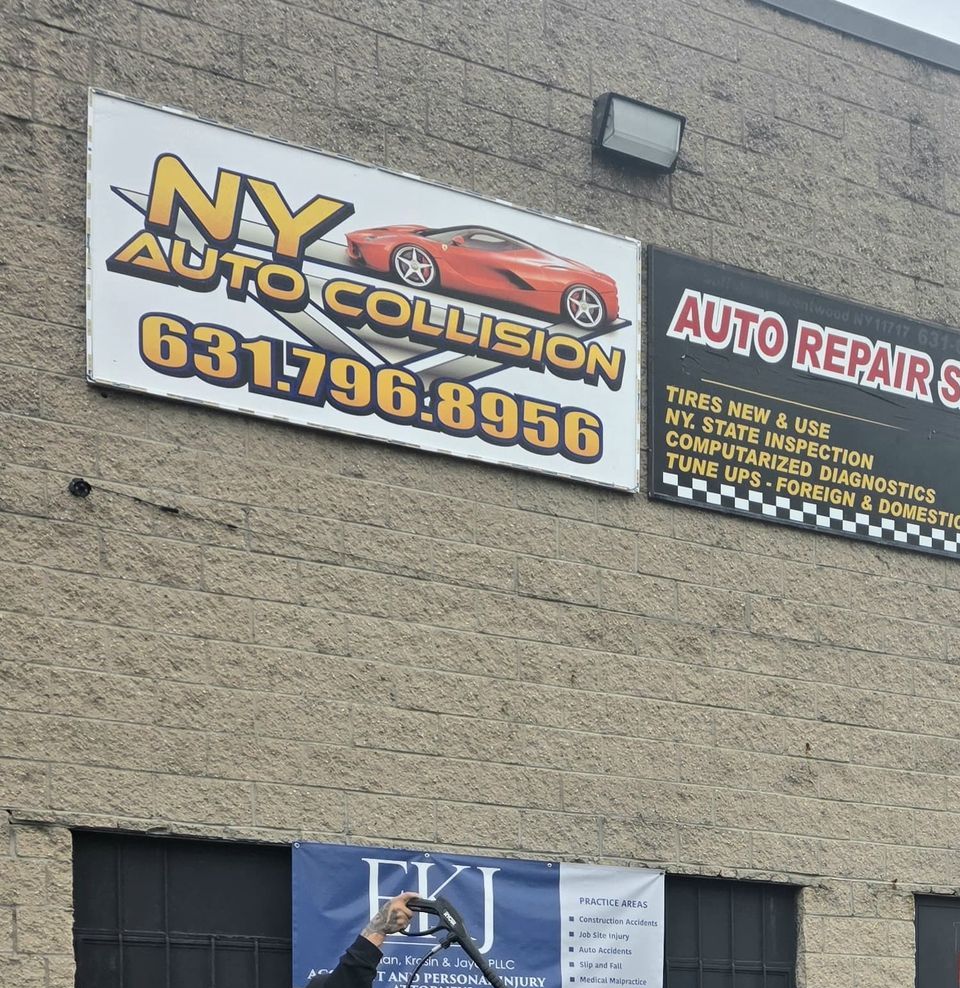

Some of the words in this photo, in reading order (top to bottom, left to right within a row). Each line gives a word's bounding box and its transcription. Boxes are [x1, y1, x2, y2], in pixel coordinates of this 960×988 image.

[148, 153, 352, 262] NY
[110, 231, 310, 306] AUTO
[324, 281, 625, 386] COLLISION
[668, 290, 787, 361] AUTO
[794, 321, 932, 400] REPAIR
[141, 313, 601, 461] 631.796.8956
[666, 385, 723, 413] TIRES
[727, 400, 771, 425] NEW
[775, 412, 788, 429] &
[795, 416, 831, 439] USE
[665, 408, 695, 429] NY.
[702, 416, 760, 444] STATE
[764, 431, 874, 470] INSPECTION
[665, 430, 812, 477] COMPUTARIZED
[819, 465, 936, 504] DIAGNOSTICS
[666, 452, 719, 479] TUNE
[724, 465, 761, 488] UPS
[776, 476, 856, 508] FOREIGN
[861, 495, 873, 511] &
[361, 857, 501, 955] EKJ
[579, 897, 620, 907] PRACTICE
[621, 900, 648, 908] AREAS
[579, 916, 624, 925] Construction
[625, 919, 658, 927] Accidents
[579, 931, 591, 939] Job
[609, 933, 630, 941] Injury
[598, 947, 632, 955] Accidents
[424, 973, 492, 986] PERSONA
[498, 975, 546, 988] NJURY
[442, 958, 451, 967] &
[489, 959, 515, 970] PLLC
[580, 961, 593, 970] Slip
[610, 962, 622, 970] Fall
[580, 976, 608, 984] Medical
[609, 977, 647, 986] Malpractice
